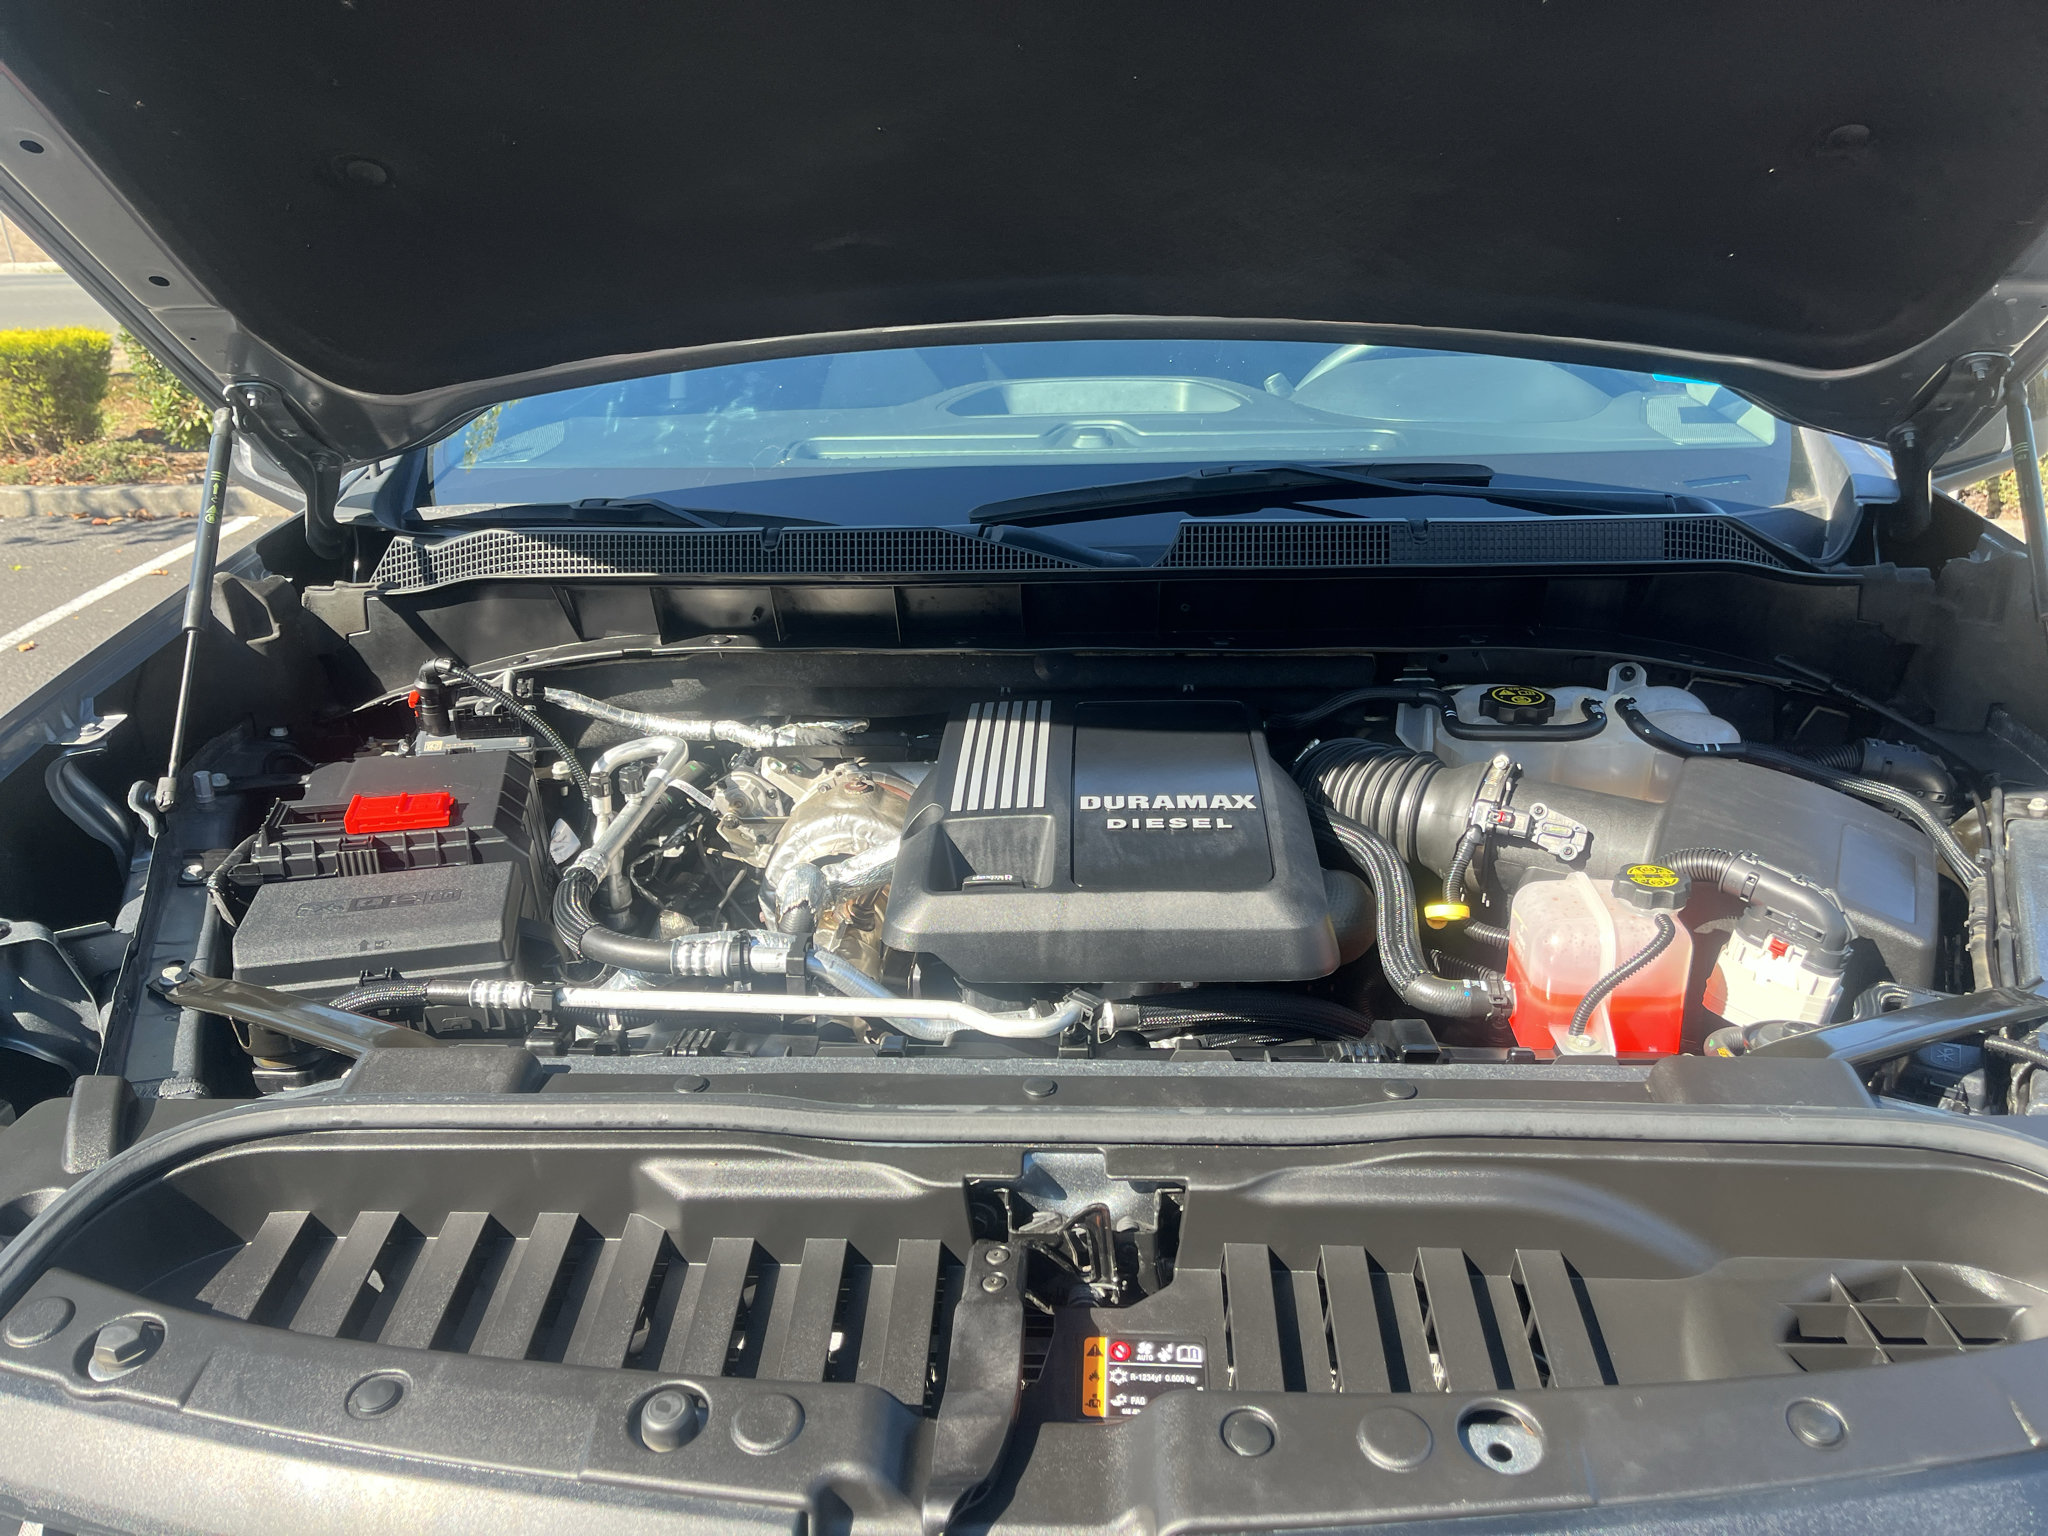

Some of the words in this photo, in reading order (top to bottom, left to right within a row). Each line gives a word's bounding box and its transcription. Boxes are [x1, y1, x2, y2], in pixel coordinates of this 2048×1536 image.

[1080, 794, 1257, 810] DURAMAX
[1106, 817, 1233, 830] DIESEL
[1136, 1354, 1154, 1362] AUTO
[1185, 1375, 1196, 1384] kg
